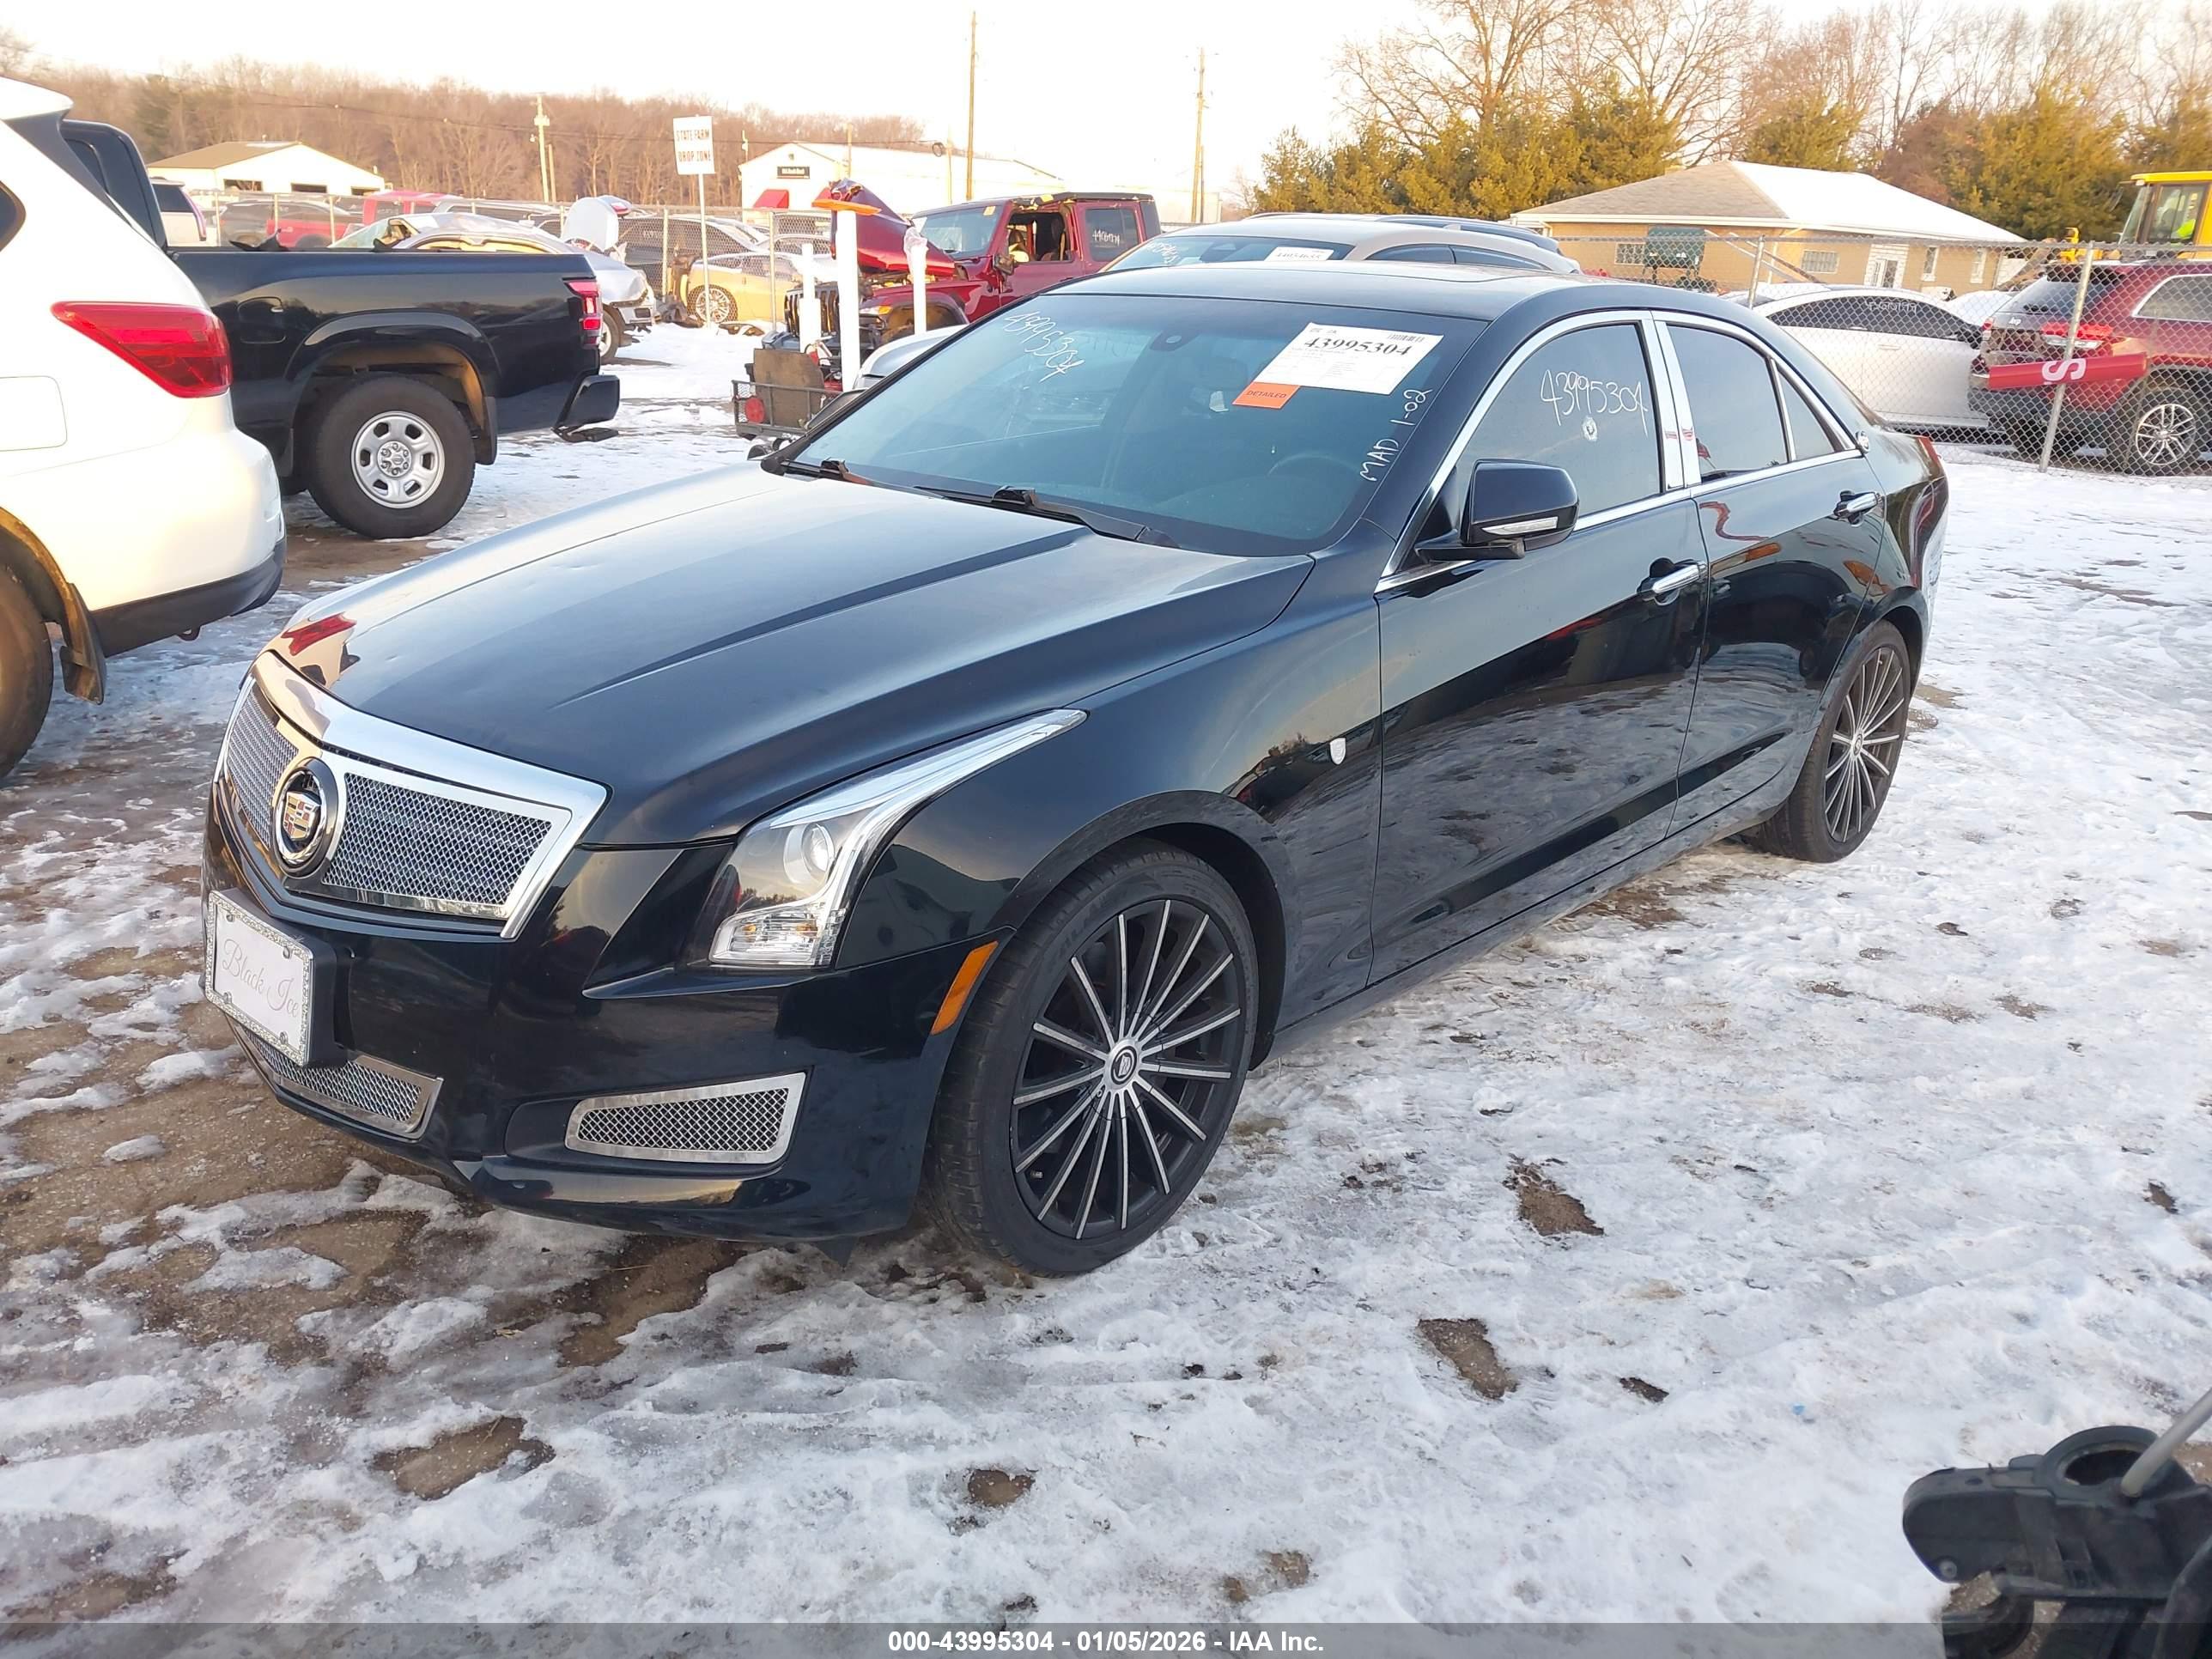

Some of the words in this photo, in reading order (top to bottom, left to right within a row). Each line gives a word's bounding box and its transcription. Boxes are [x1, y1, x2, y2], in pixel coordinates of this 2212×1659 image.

[676, 130, 692, 141] STATE
[694, 128, 710, 139] FARM
[678, 150, 695, 161] DROP
[1304, 337, 1413, 356] 43995304
[1246, 390, 1287, 399] DETAILED
[1540, 369, 1648, 438] 43995304
[1359, 439, 1399, 481] MAD
[1390, 390, 1433, 426] 1-02
[222, 938, 264, 994] Black
[267, 976, 300, 1018] Ice
